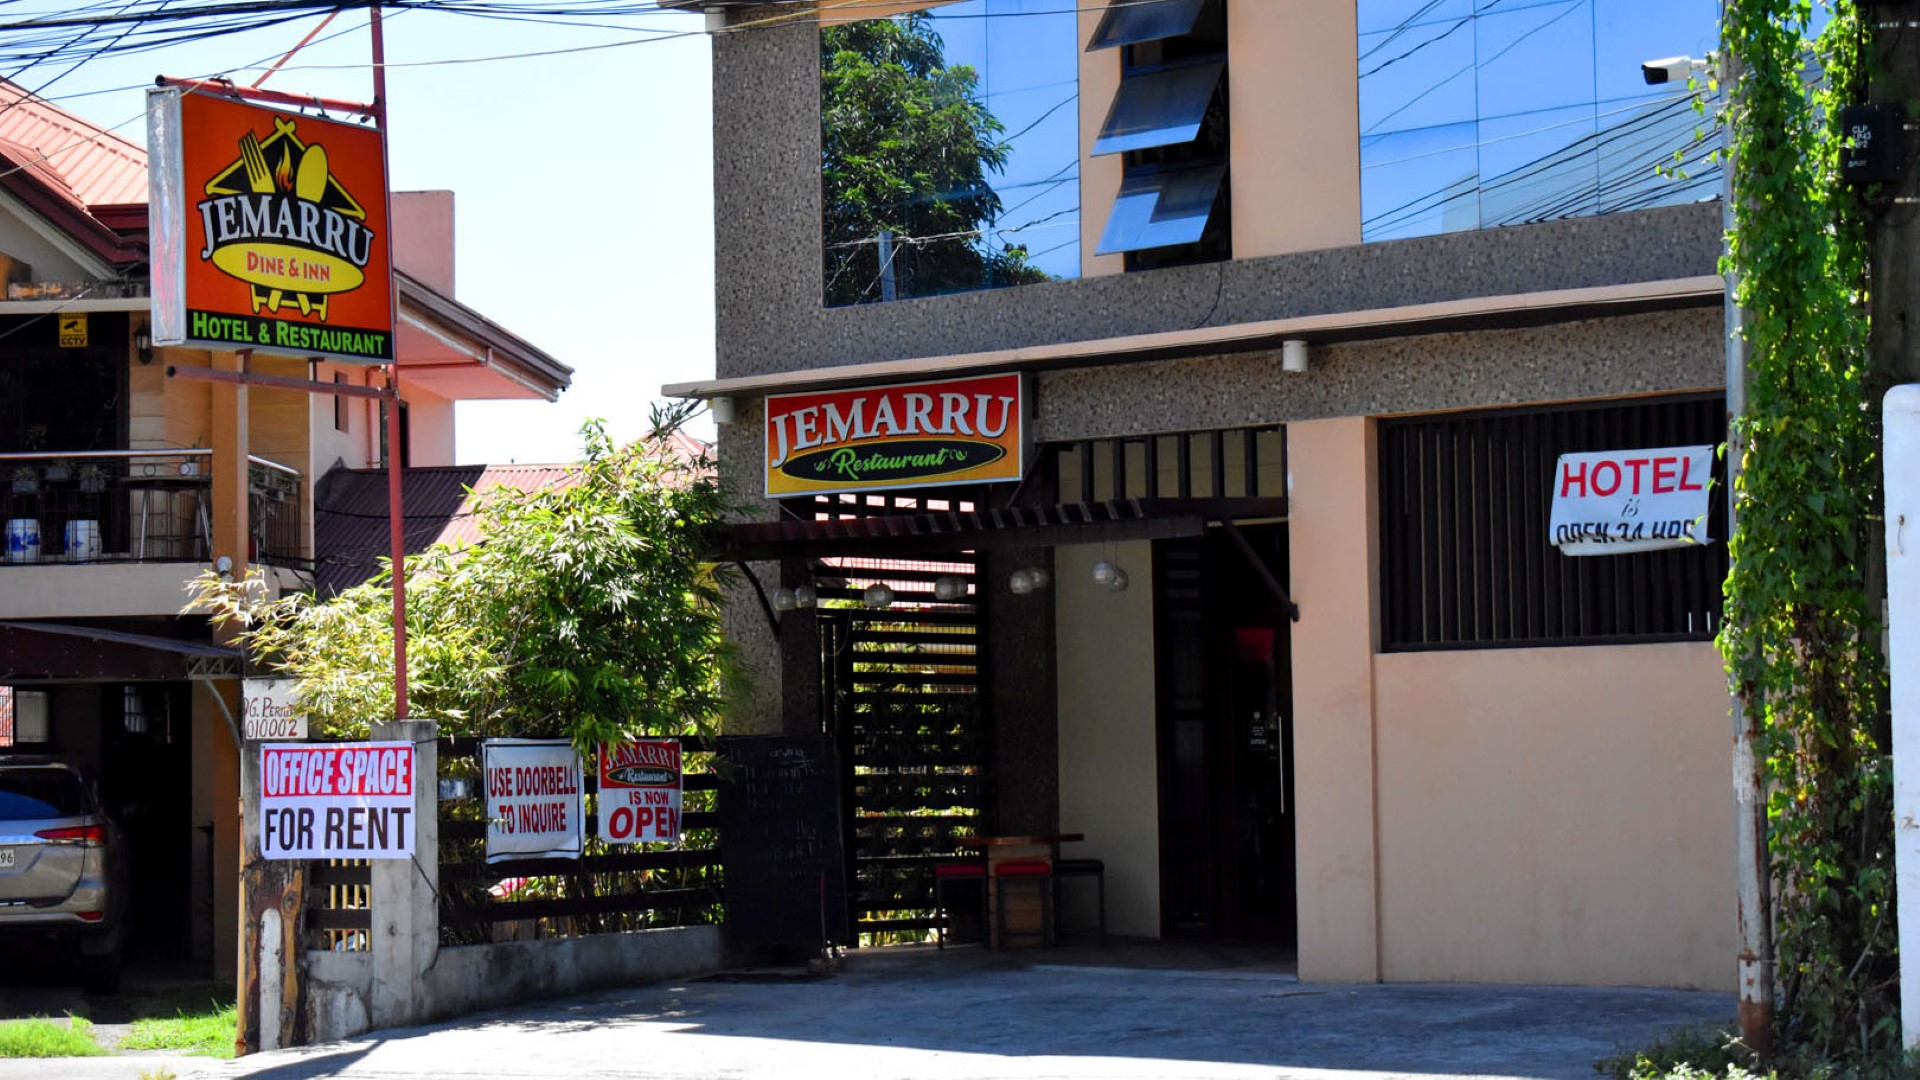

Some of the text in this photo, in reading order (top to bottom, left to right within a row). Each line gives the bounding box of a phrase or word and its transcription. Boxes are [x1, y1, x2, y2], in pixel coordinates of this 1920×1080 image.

[199, 194, 375, 266] JEMARRU
[246, 250, 330, 282] DINE & INN
[61, 336, 86, 346] CCTV
[193, 312, 385, 355] HOTEL & RESTAURANT
[771, 392, 1015, 468] JEMARRU
[831, 447, 949, 481] Restaurant
[1560, 456, 1703, 498] HOTEL
[266, 749, 409, 796] OFFICE SPACE
[488, 766, 577, 798] USE DOORBELL
[629, 791, 669, 805] IS NOW
[265, 806, 411, 851] FOR RENT
[499, 803, 567, 835] TO INQUIRE
[608, 806, 679, 839] OPEN
